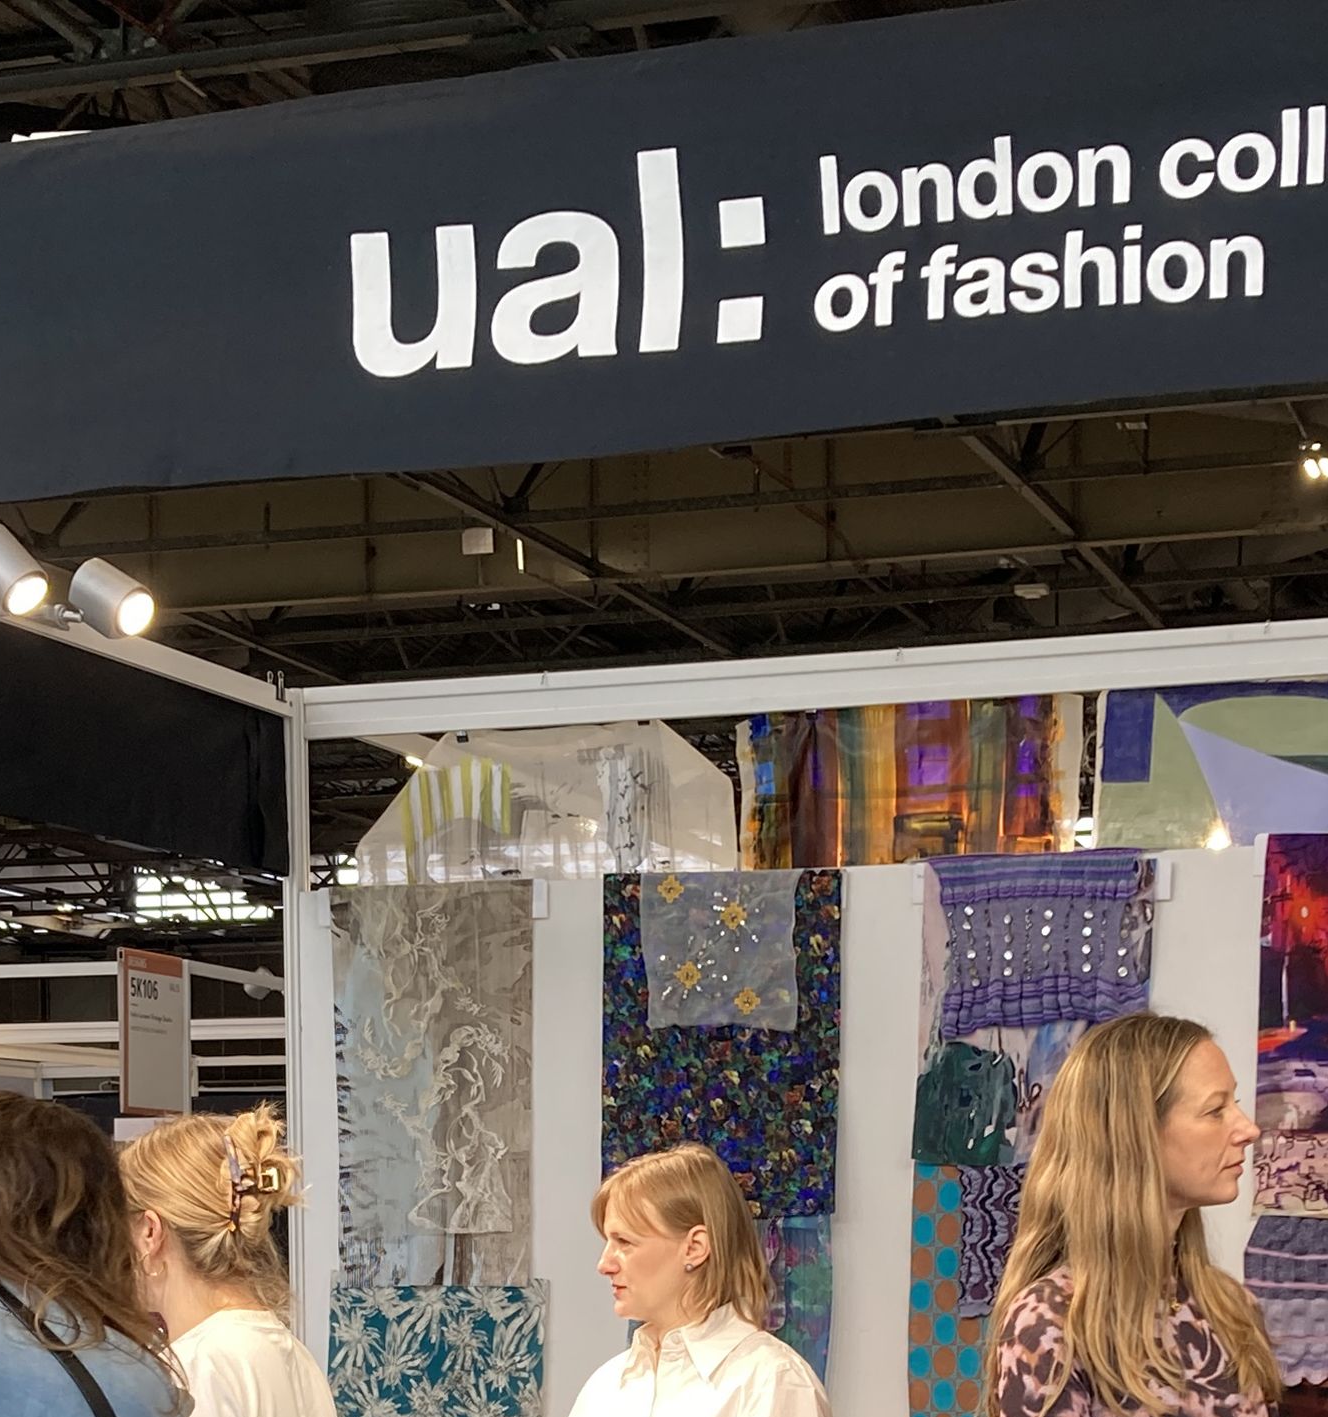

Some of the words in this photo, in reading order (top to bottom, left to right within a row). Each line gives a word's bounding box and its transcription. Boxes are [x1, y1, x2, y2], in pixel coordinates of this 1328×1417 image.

[818, 136, 1130, 235] london
[350, 147, 766, 378] ual:
[813, 245, 906, 331] of
[920, 225, 1265, 320] fashion
[130, 976, 159, 1000] 5K106
